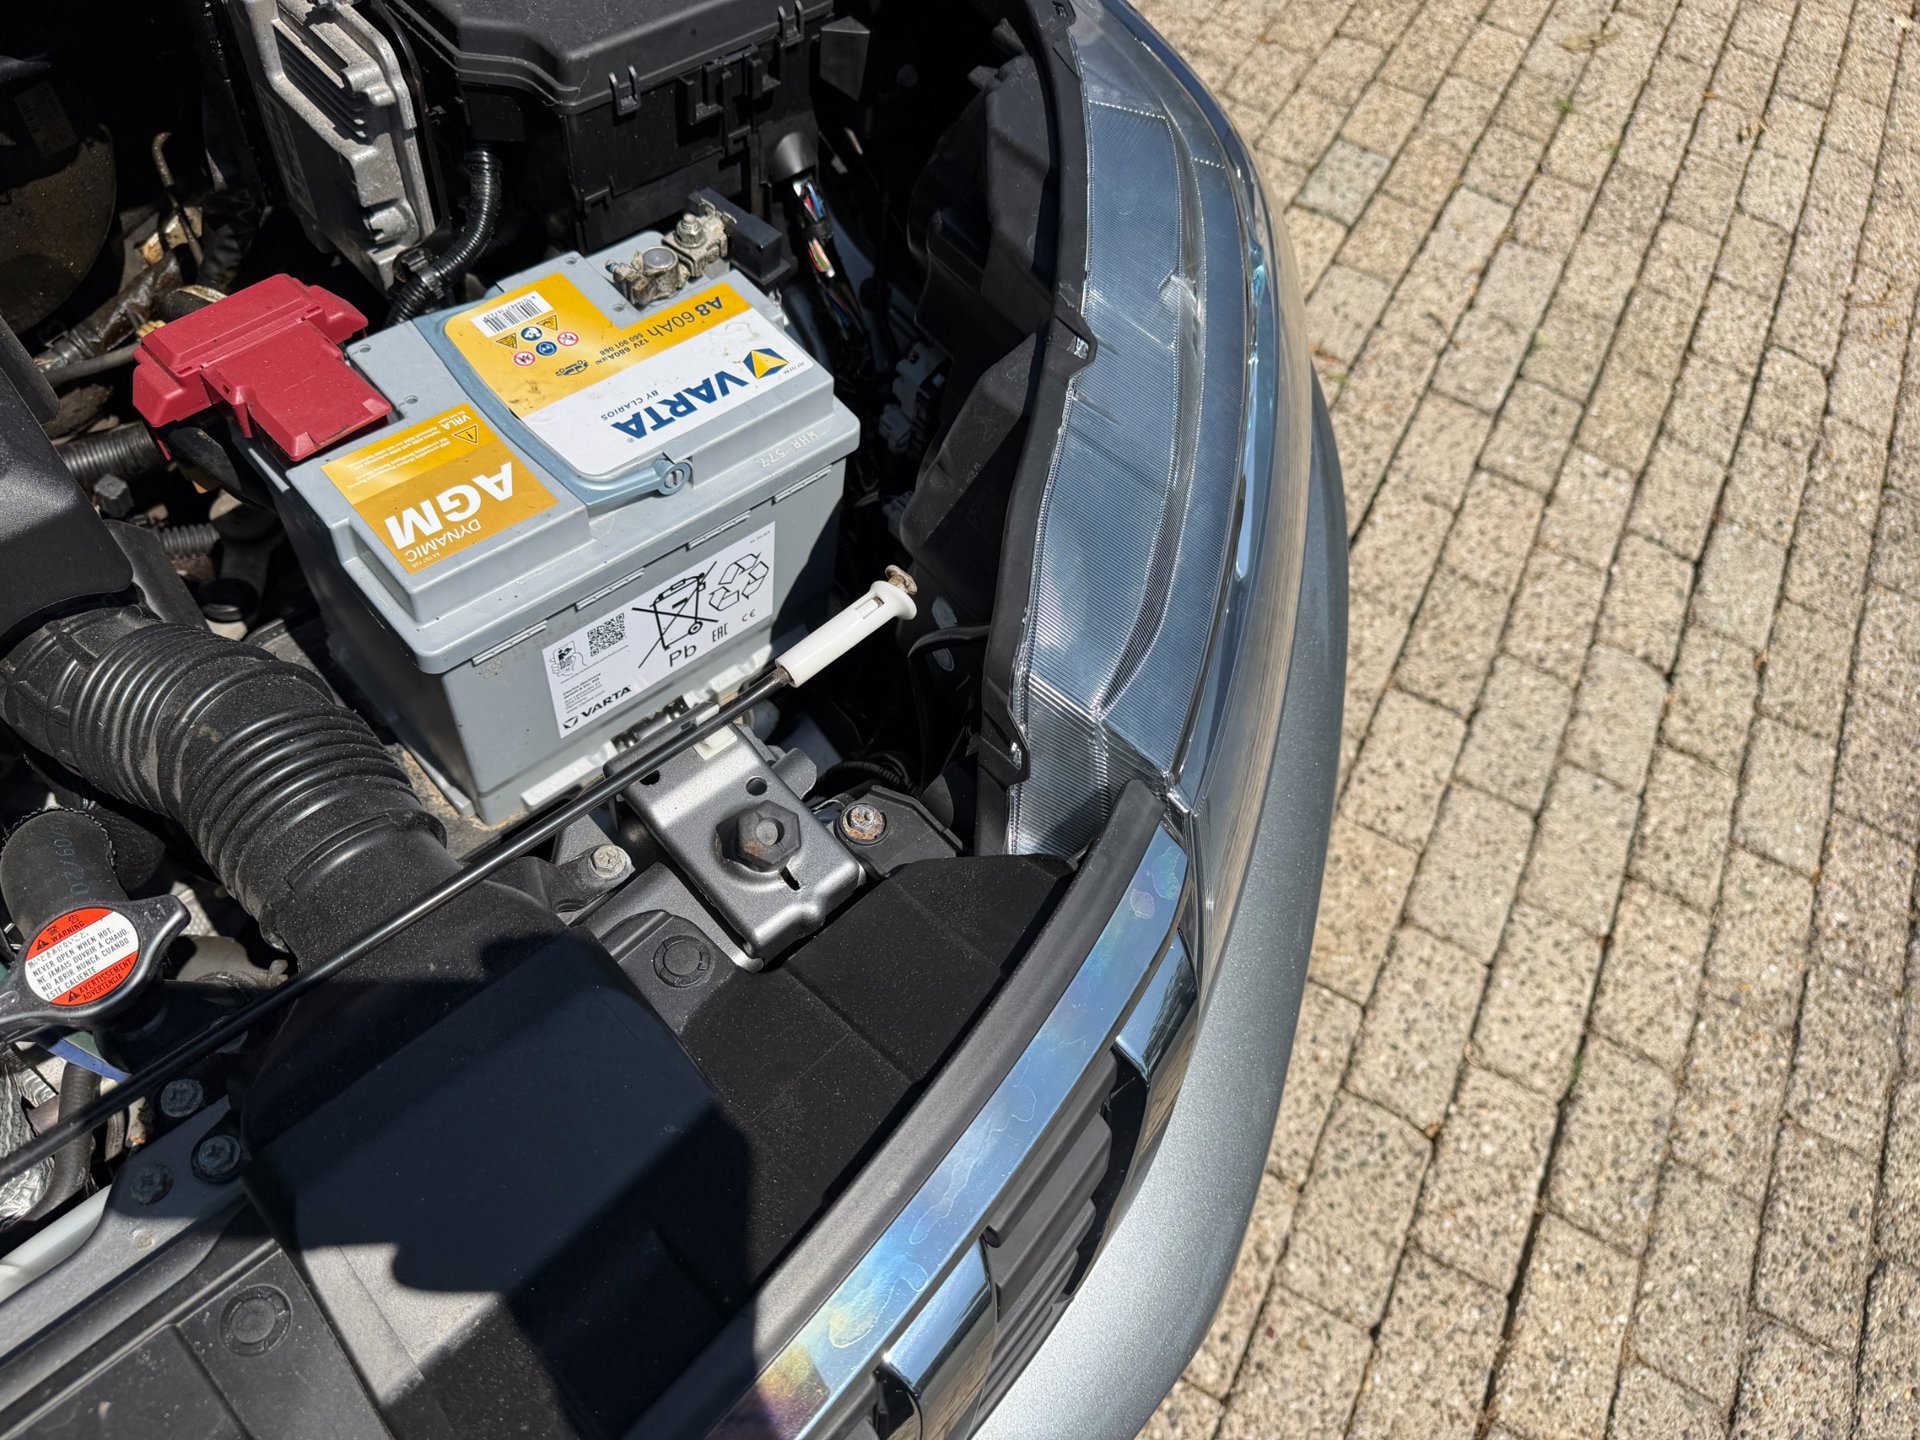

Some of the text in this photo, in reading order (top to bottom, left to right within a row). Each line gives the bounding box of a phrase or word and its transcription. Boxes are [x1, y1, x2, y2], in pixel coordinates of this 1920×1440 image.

[646, 295, 722, 340] A8 60Ah
[632, 337, 650, 348] 12V
[440, 413, 472, 431] VRLA
[600, 389, 659, 422] BY CLARIOS
[610, 369, 749, 442] VARTA
[384, 460, 515, 550] AGM
[404, 518, 482, 563] DYNAMIC
[668, 643, 698, 668] Pb
[580, 687, 631, 717] VARTA
[50, 919, 85, 943] WARNING
[31, 959, 55, 977] NEVER
[55, 948, 75, 963] OPEN
[75, 935, 97, 951] WHEN
[35, 974, 47, 985] NE
[47, 959, 72, 979] JAMAIS
[72, 945, 97, 963] OUVRIR
[40, 937, 130, 992] NO ABRIR NUNCA CUANDO
[45, 985, 63, 1000] ESTE
[78, 957, 133, 994] AVERTISSEMENT
[83, 972, 124, 1001] ADVERTENCIA
